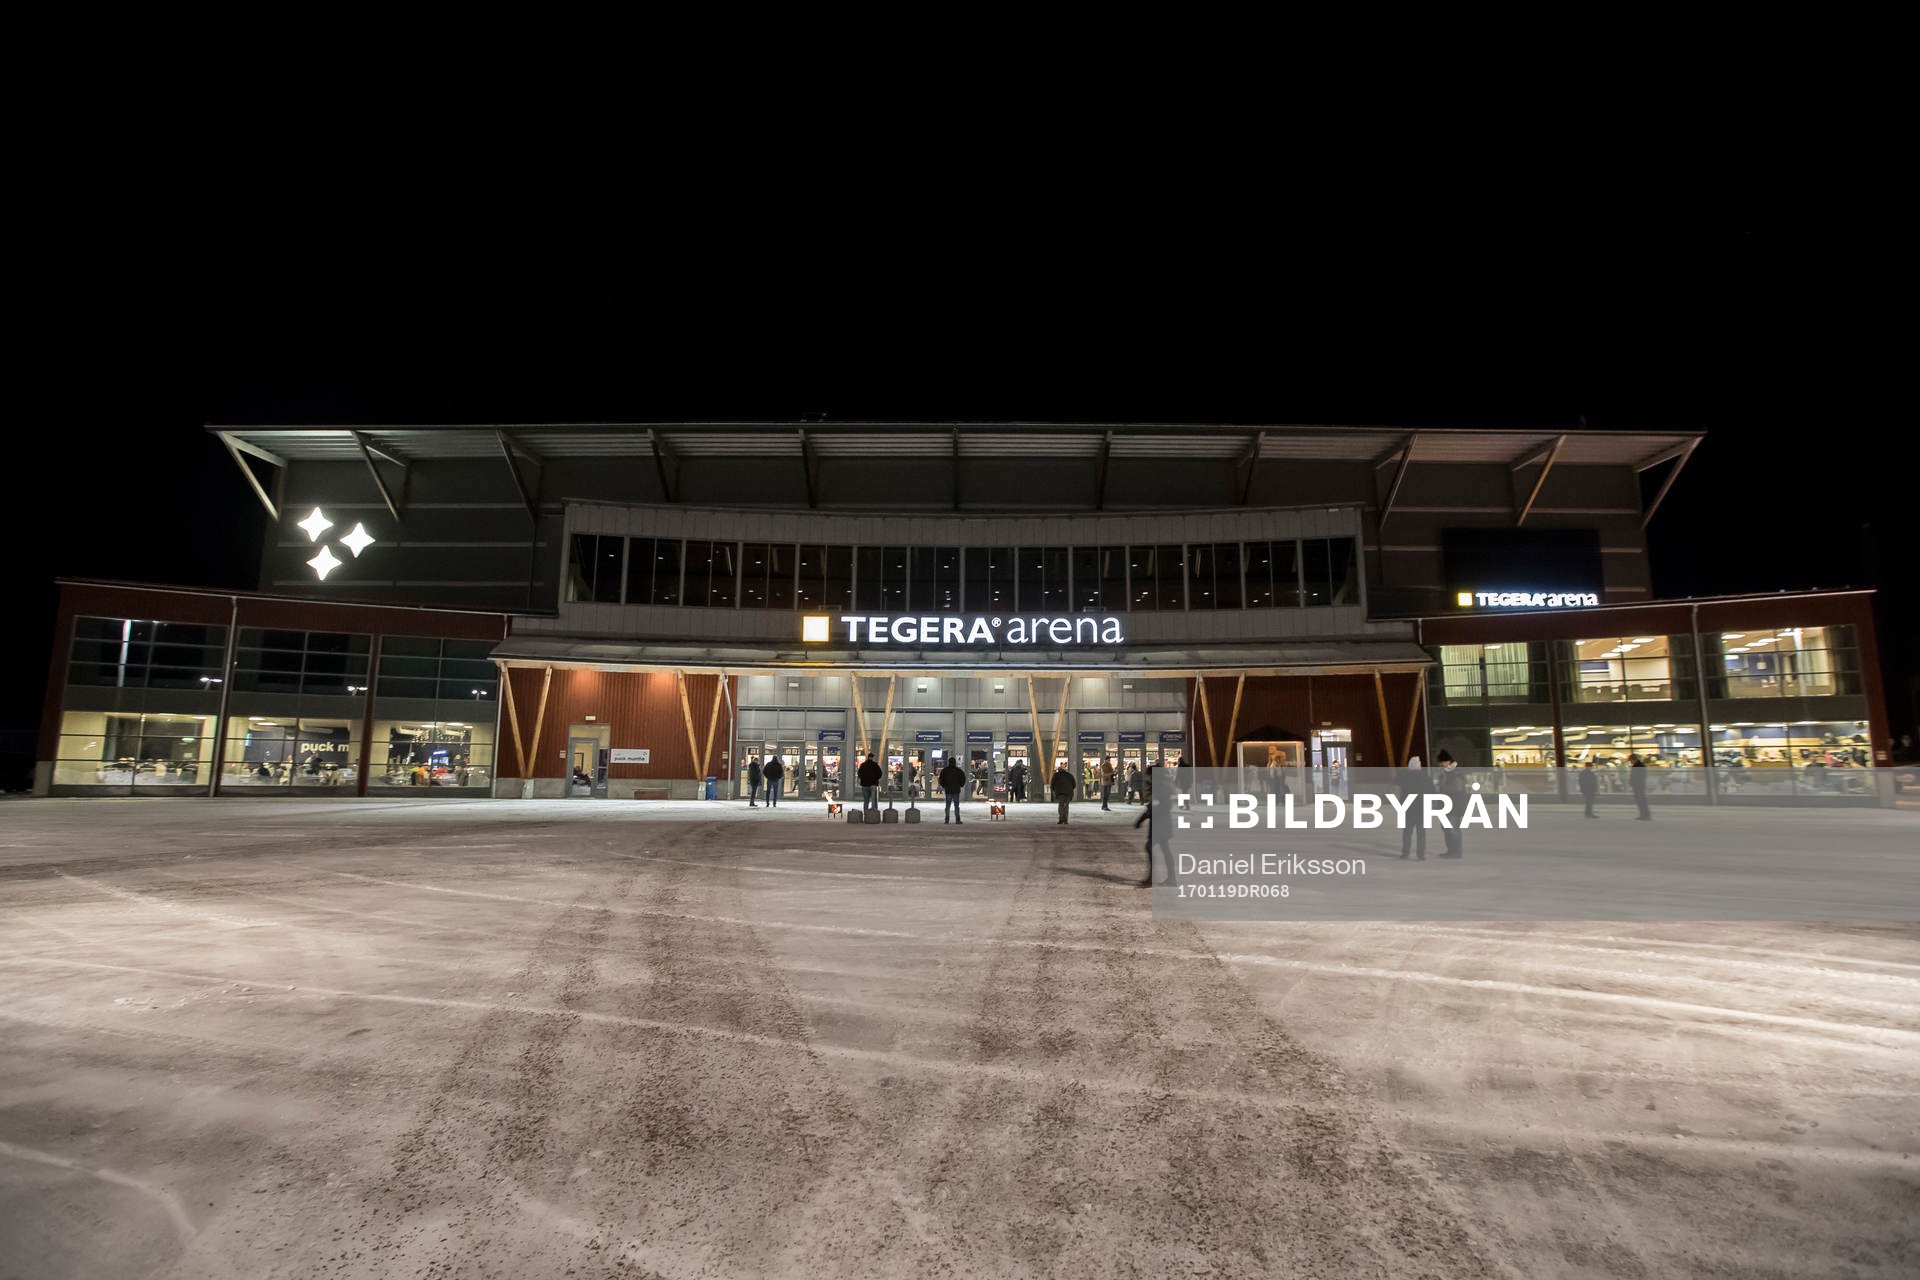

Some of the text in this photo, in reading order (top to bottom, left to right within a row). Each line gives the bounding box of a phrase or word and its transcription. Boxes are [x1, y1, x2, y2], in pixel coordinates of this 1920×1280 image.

[1547, 593, 1599, 607] arena
[1007, 616, 1124, 644] arena
[300, 741, 335, 753] puck
